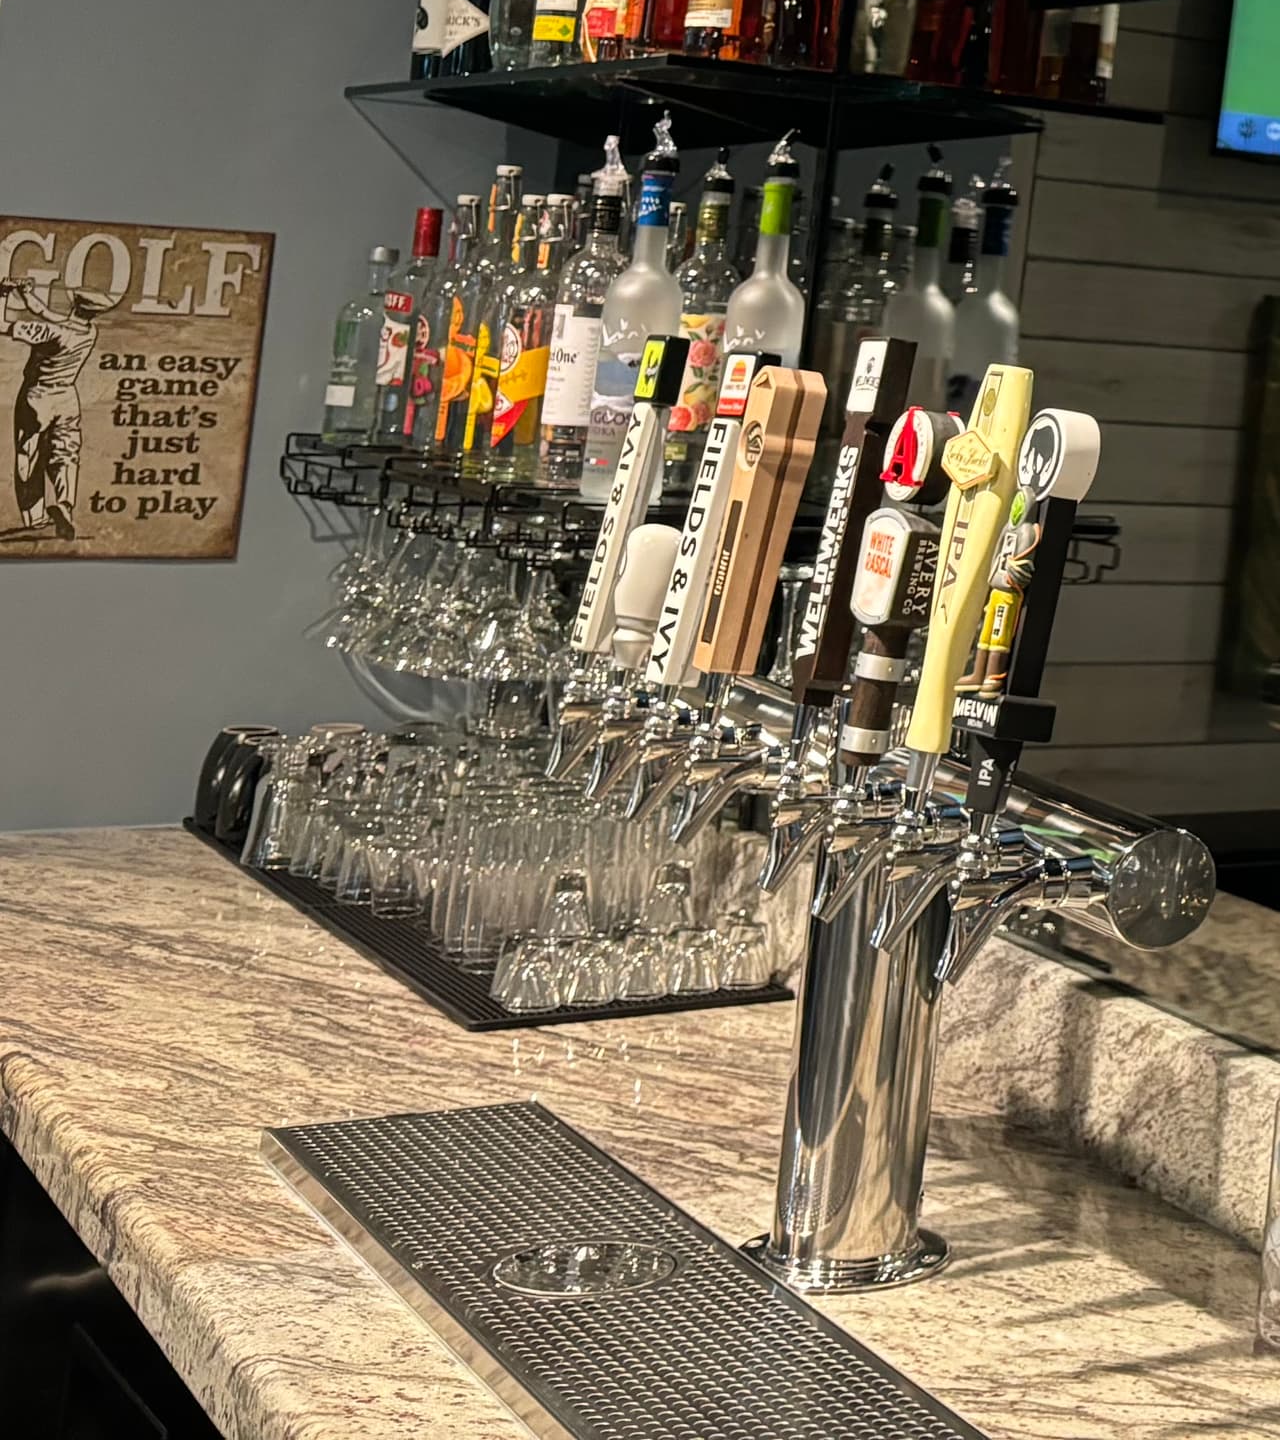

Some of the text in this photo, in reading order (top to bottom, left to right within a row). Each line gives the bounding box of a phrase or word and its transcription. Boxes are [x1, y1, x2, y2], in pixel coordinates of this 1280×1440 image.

[0, 230, 261, 317] GOLF
[99, 353, 242, 380] an easy
[116, 377, 219, 401] game
[112, 405, 218, 428] that's
[122, 431, 200, 458] just
[879, 405, 924, 488] A
[112, 463, 201, 485] hard
[89, 491, 218, 519] to play
[649, 422, 727, 675] FIELDS & IVY
[794, 444, 860, 661] WELDWERKS
[869, 531, 896, 557] WHITE
[573, 482, 625, 644] FIELDS &
[864, 547, 892, 580] RASCAL
[954, 697, 999, 728] MELVIN
[977, 758, 995, 787] IPA
